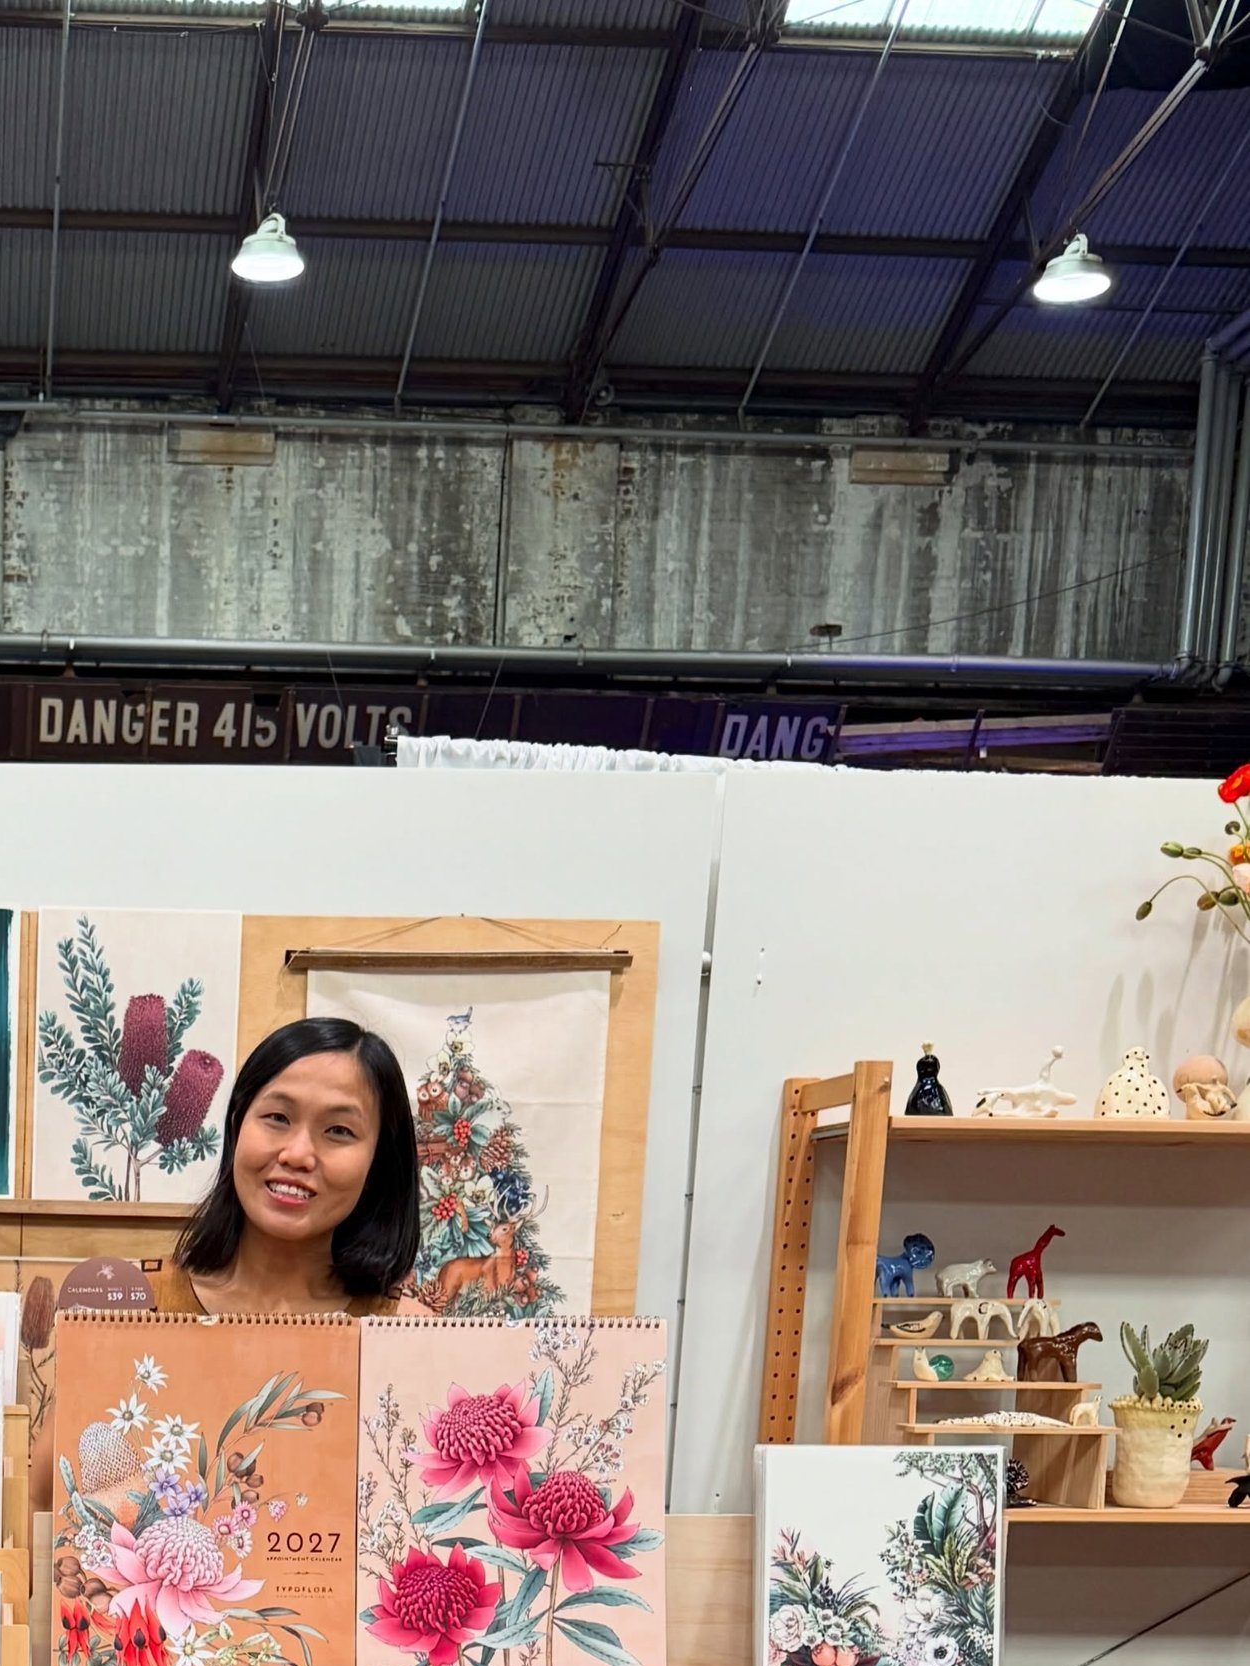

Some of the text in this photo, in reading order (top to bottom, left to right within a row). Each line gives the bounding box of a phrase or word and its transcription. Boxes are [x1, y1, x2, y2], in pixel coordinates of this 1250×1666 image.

[39, 697, 199, 749] DANGER
[212, 702, 279, 749] 415
[719, 713, 832, 760] DANG
[107, 1292, 146, 1301] $39 $70
[267, 1532, 341, 1553] 2027
